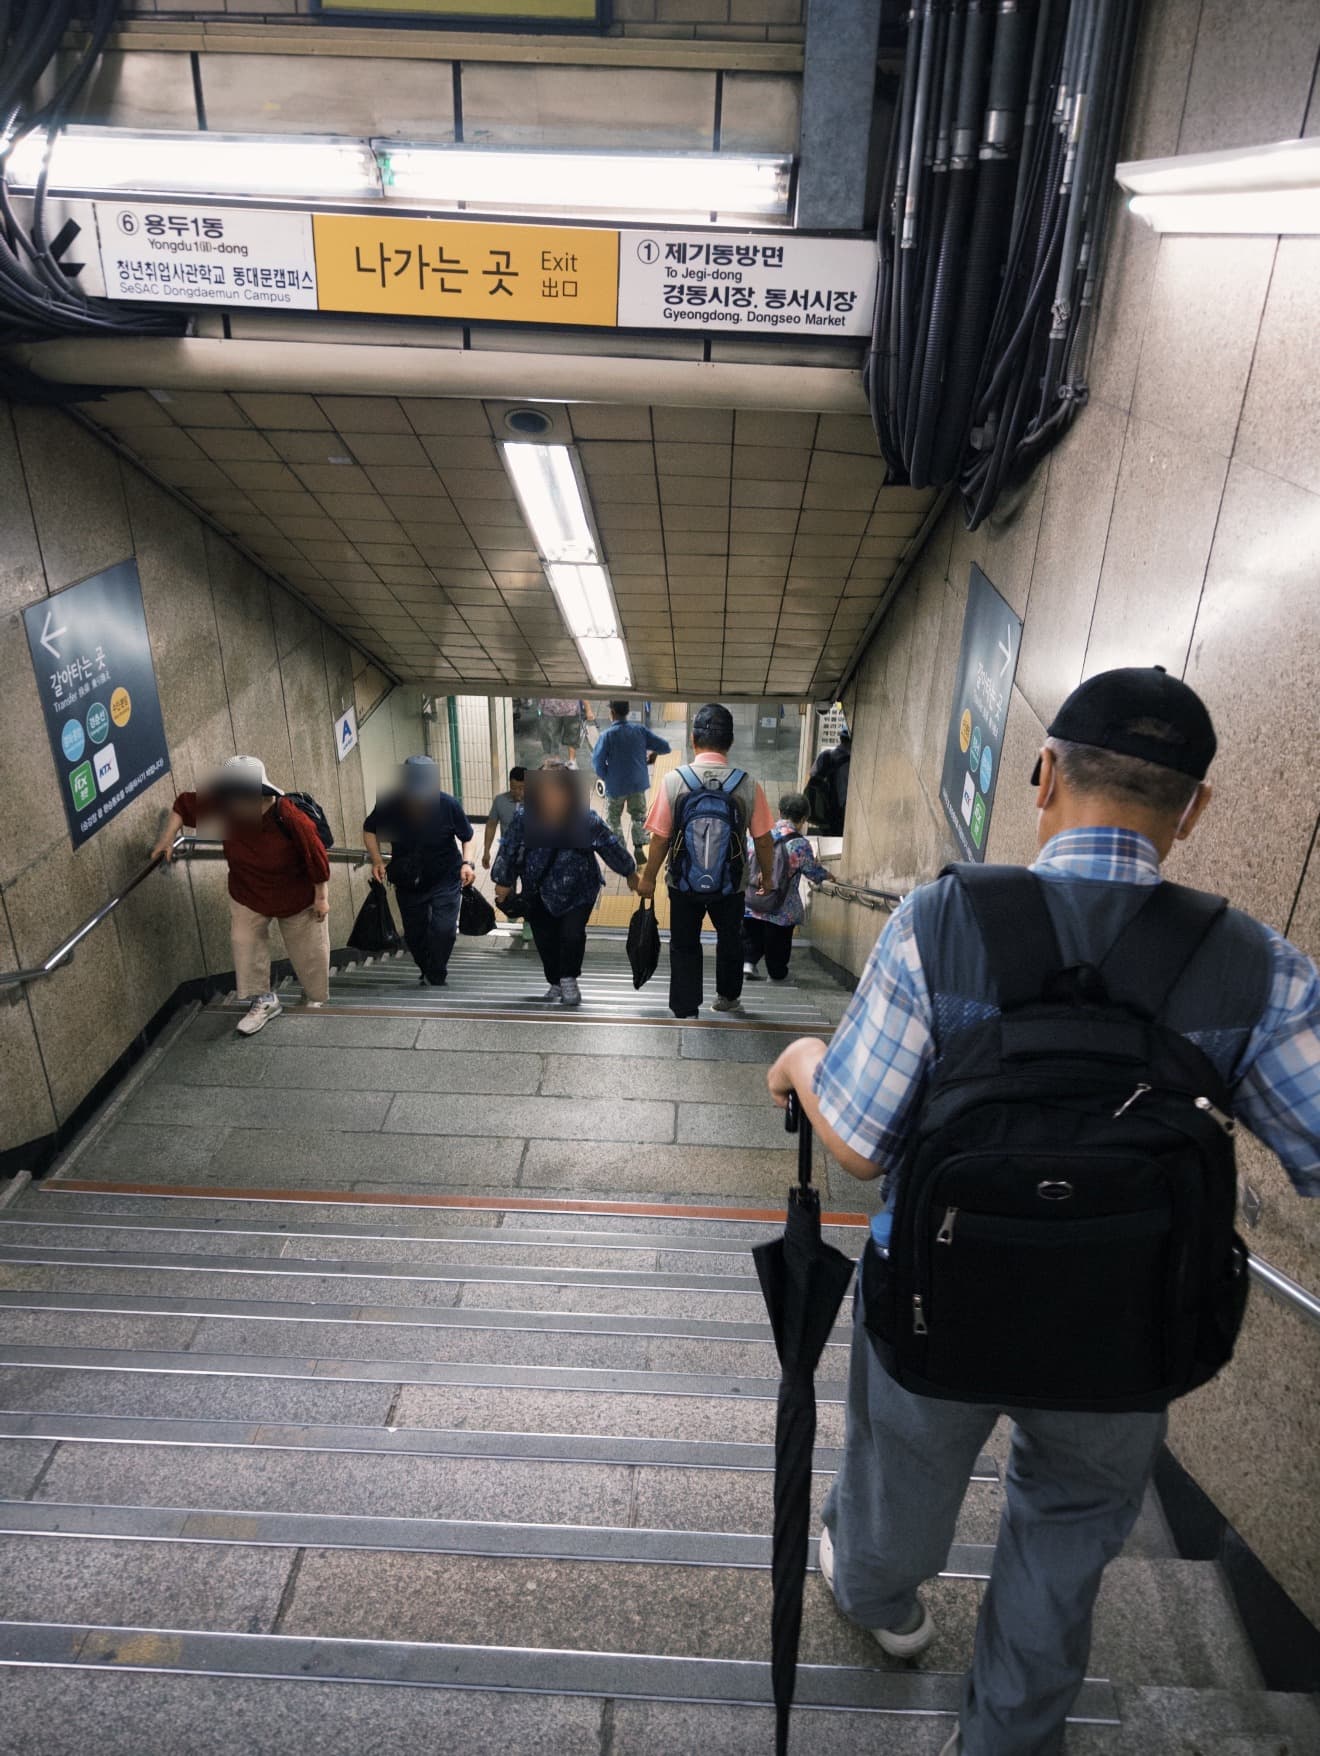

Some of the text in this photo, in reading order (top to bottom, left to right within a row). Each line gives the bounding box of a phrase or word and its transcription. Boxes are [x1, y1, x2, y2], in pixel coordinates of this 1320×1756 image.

[144, 213, 224, 239] 용두1동
[541, 250, 578, 273] Exit
[665, 242, 784, 267] 제기동방면
[117, 260, 314, 290] 청년취업사관학교 동대문캠퍼스
[355, 242, 519, 296] 나가는 곳
[664, 266, 743, 283] To Jegi-dong
[120, 282, 291, 303] SeSAC Dongdaemun Campus
[541, 277, 578, 298] 出口
[764, 288, 858, 312] 동서시장
[747, 310, 801, 326] Dongseo
[805, 313, 846, 327] Market
[50, 655, 93, 698] 갈아타는
[95, 646, 106, 671] 곳
[99, 757, 112, 778] KTX
